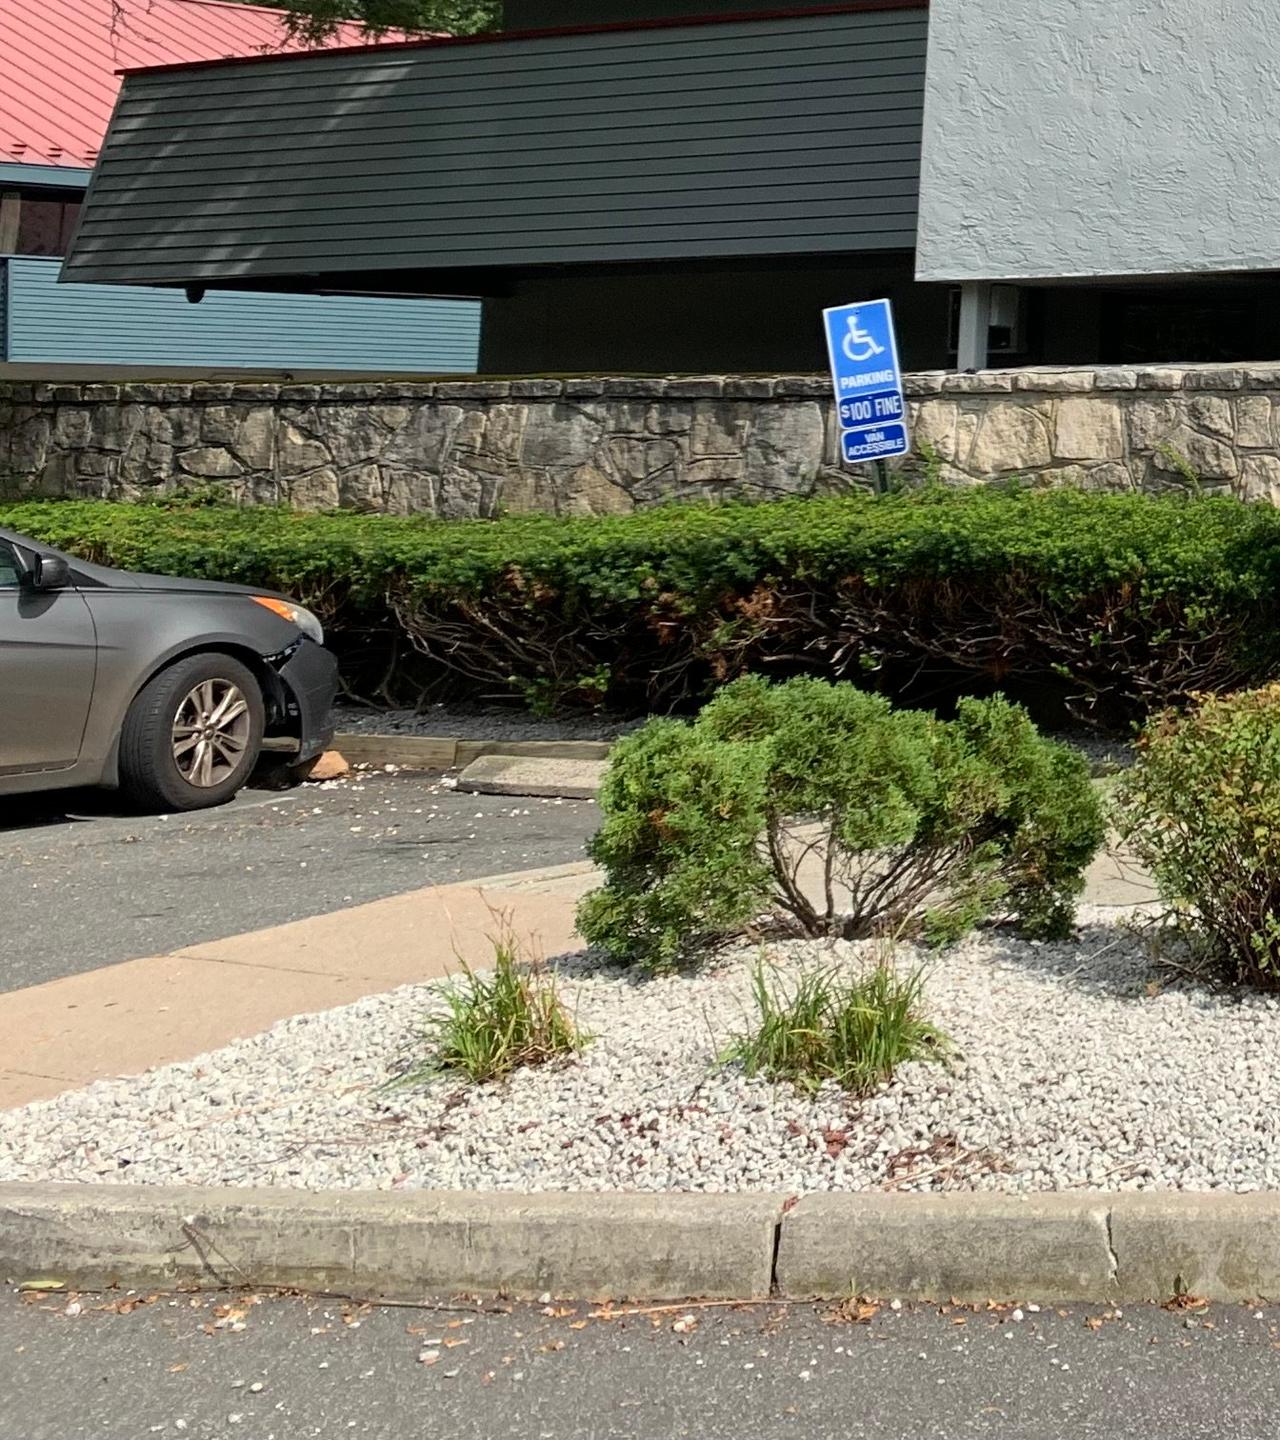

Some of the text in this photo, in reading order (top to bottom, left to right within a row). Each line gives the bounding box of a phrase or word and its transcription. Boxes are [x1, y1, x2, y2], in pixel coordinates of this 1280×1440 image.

[840, 369, 895, 390] PARKING
[874, 395, 901, 417] FINE
[848, 437, 905, 456] ACCESSIBLE
[864, 431, 885, 444] VAN
